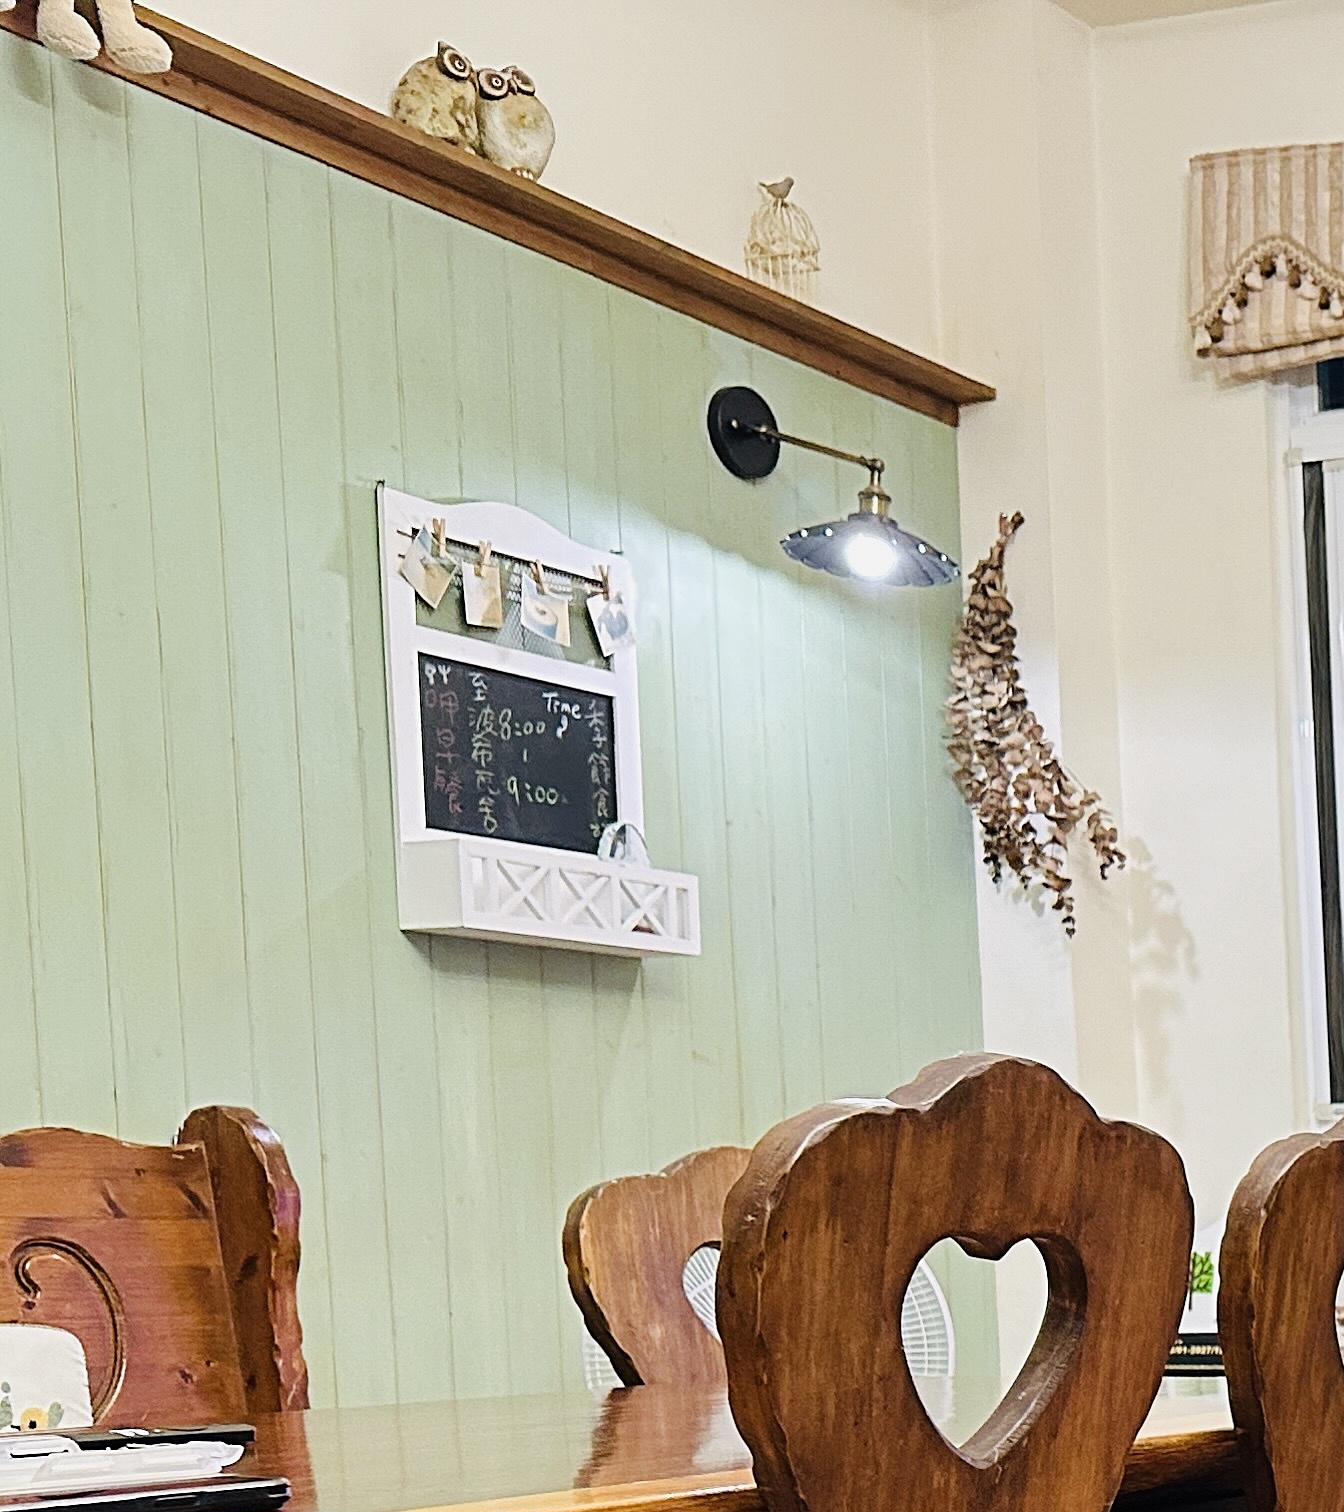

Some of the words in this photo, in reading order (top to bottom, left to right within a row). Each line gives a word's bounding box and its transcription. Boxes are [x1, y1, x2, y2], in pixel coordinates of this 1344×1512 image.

[542, 691, 582, 719] Time
[500, 708, 546, 740] 8:00
[507, 776, 559, 806] 9:00
